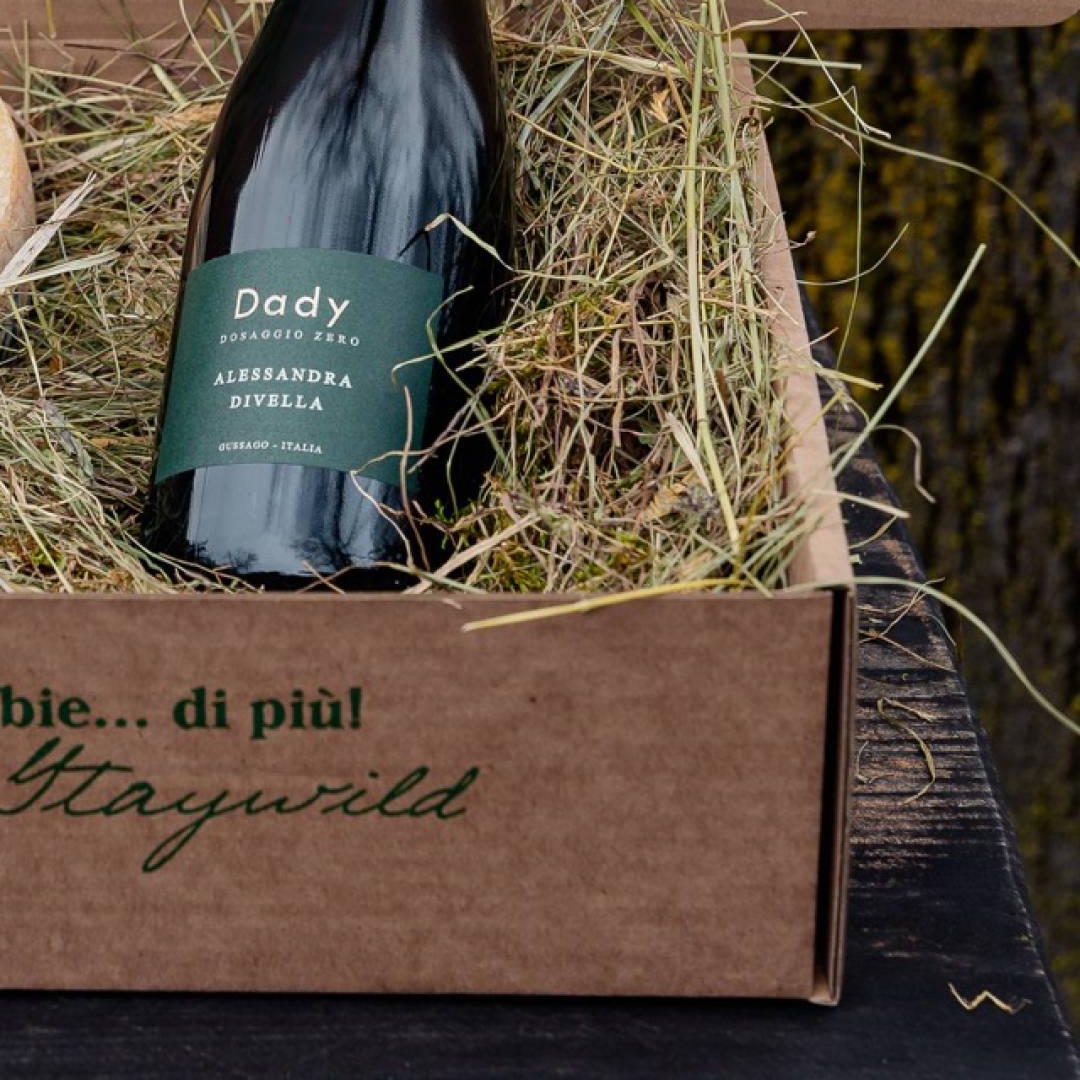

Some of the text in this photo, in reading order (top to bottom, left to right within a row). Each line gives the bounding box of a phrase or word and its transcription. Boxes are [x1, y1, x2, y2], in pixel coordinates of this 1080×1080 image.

[234, 286, 350, 328] Dady
[220, 329, 361, 347] DOSAGGIO ZERO
[213, 367, 353, 389] ALESSANDRA
[229, 394, 324, 411] DIVELLA
[218, 440, 269, 452] GUSSAGO
[281, 441, 323, 455] ITALIA
[172, 686, 231, 729] di
[250, 686, 363, 740] più!
